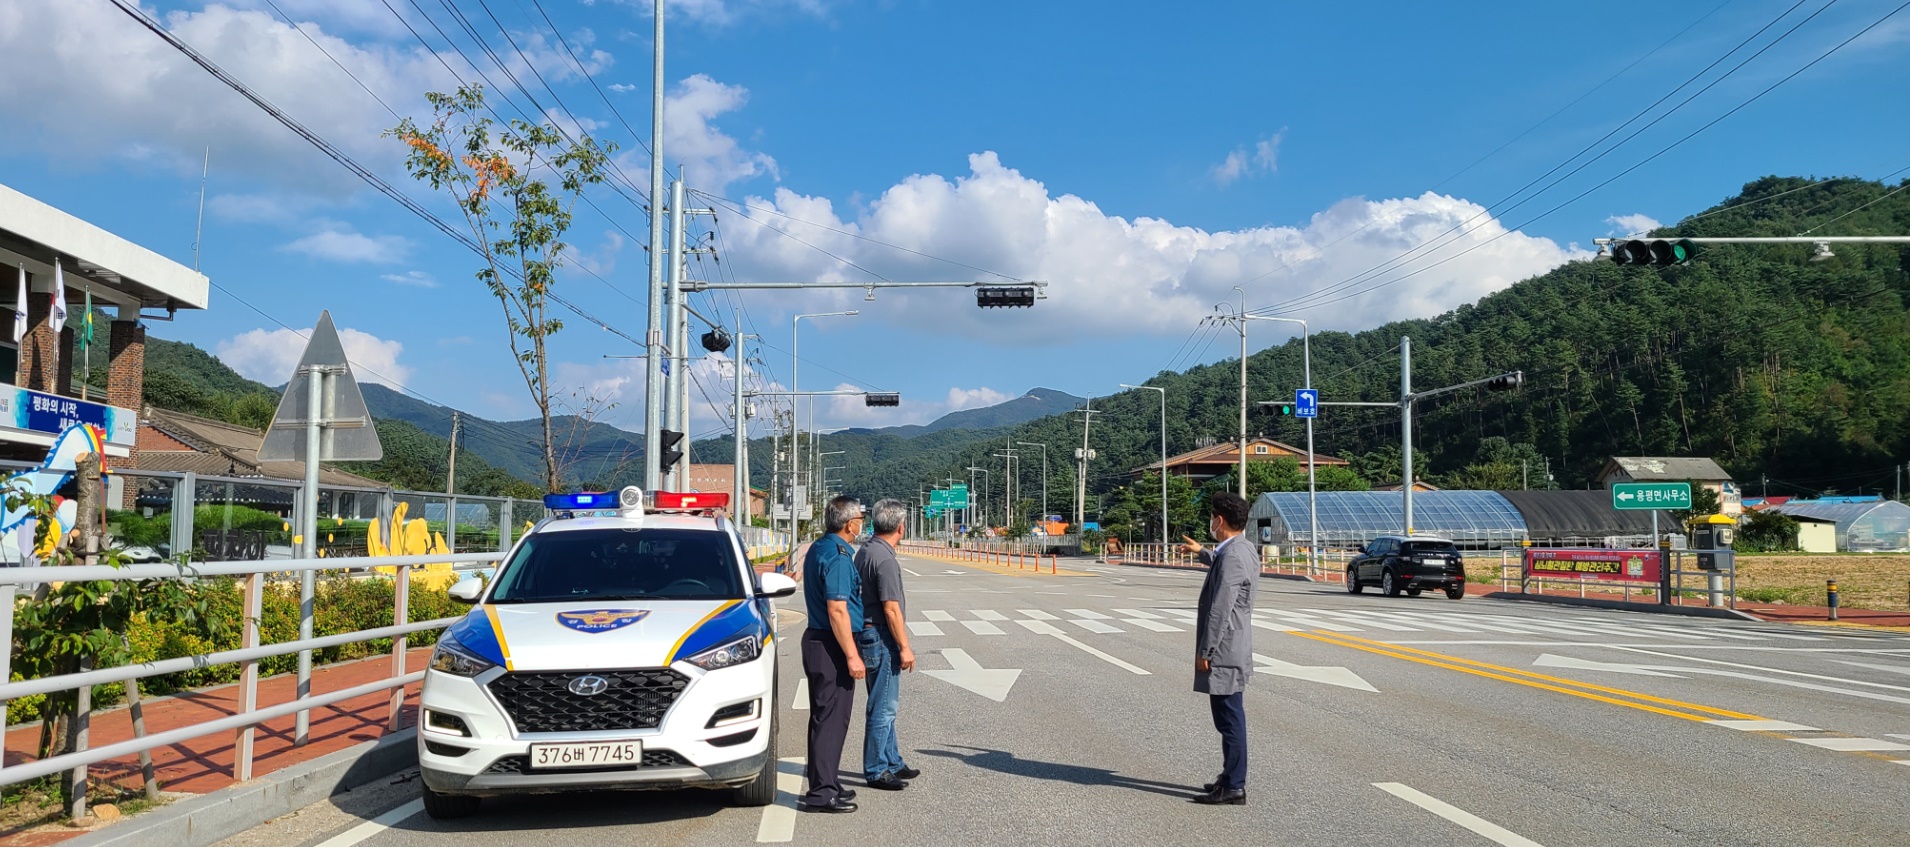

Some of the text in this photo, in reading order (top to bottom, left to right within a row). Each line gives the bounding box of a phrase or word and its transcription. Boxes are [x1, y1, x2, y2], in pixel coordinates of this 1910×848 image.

[33, 396, 79, 419] 평화의 시작,
[1297, 407, 1315, 415] 비보호
[1636, 489, 1688, 502] 용평면사무소
[1575, 561, 1620, 573] 예방관리주간
[538, 745, 635, 764] 376버 7745
